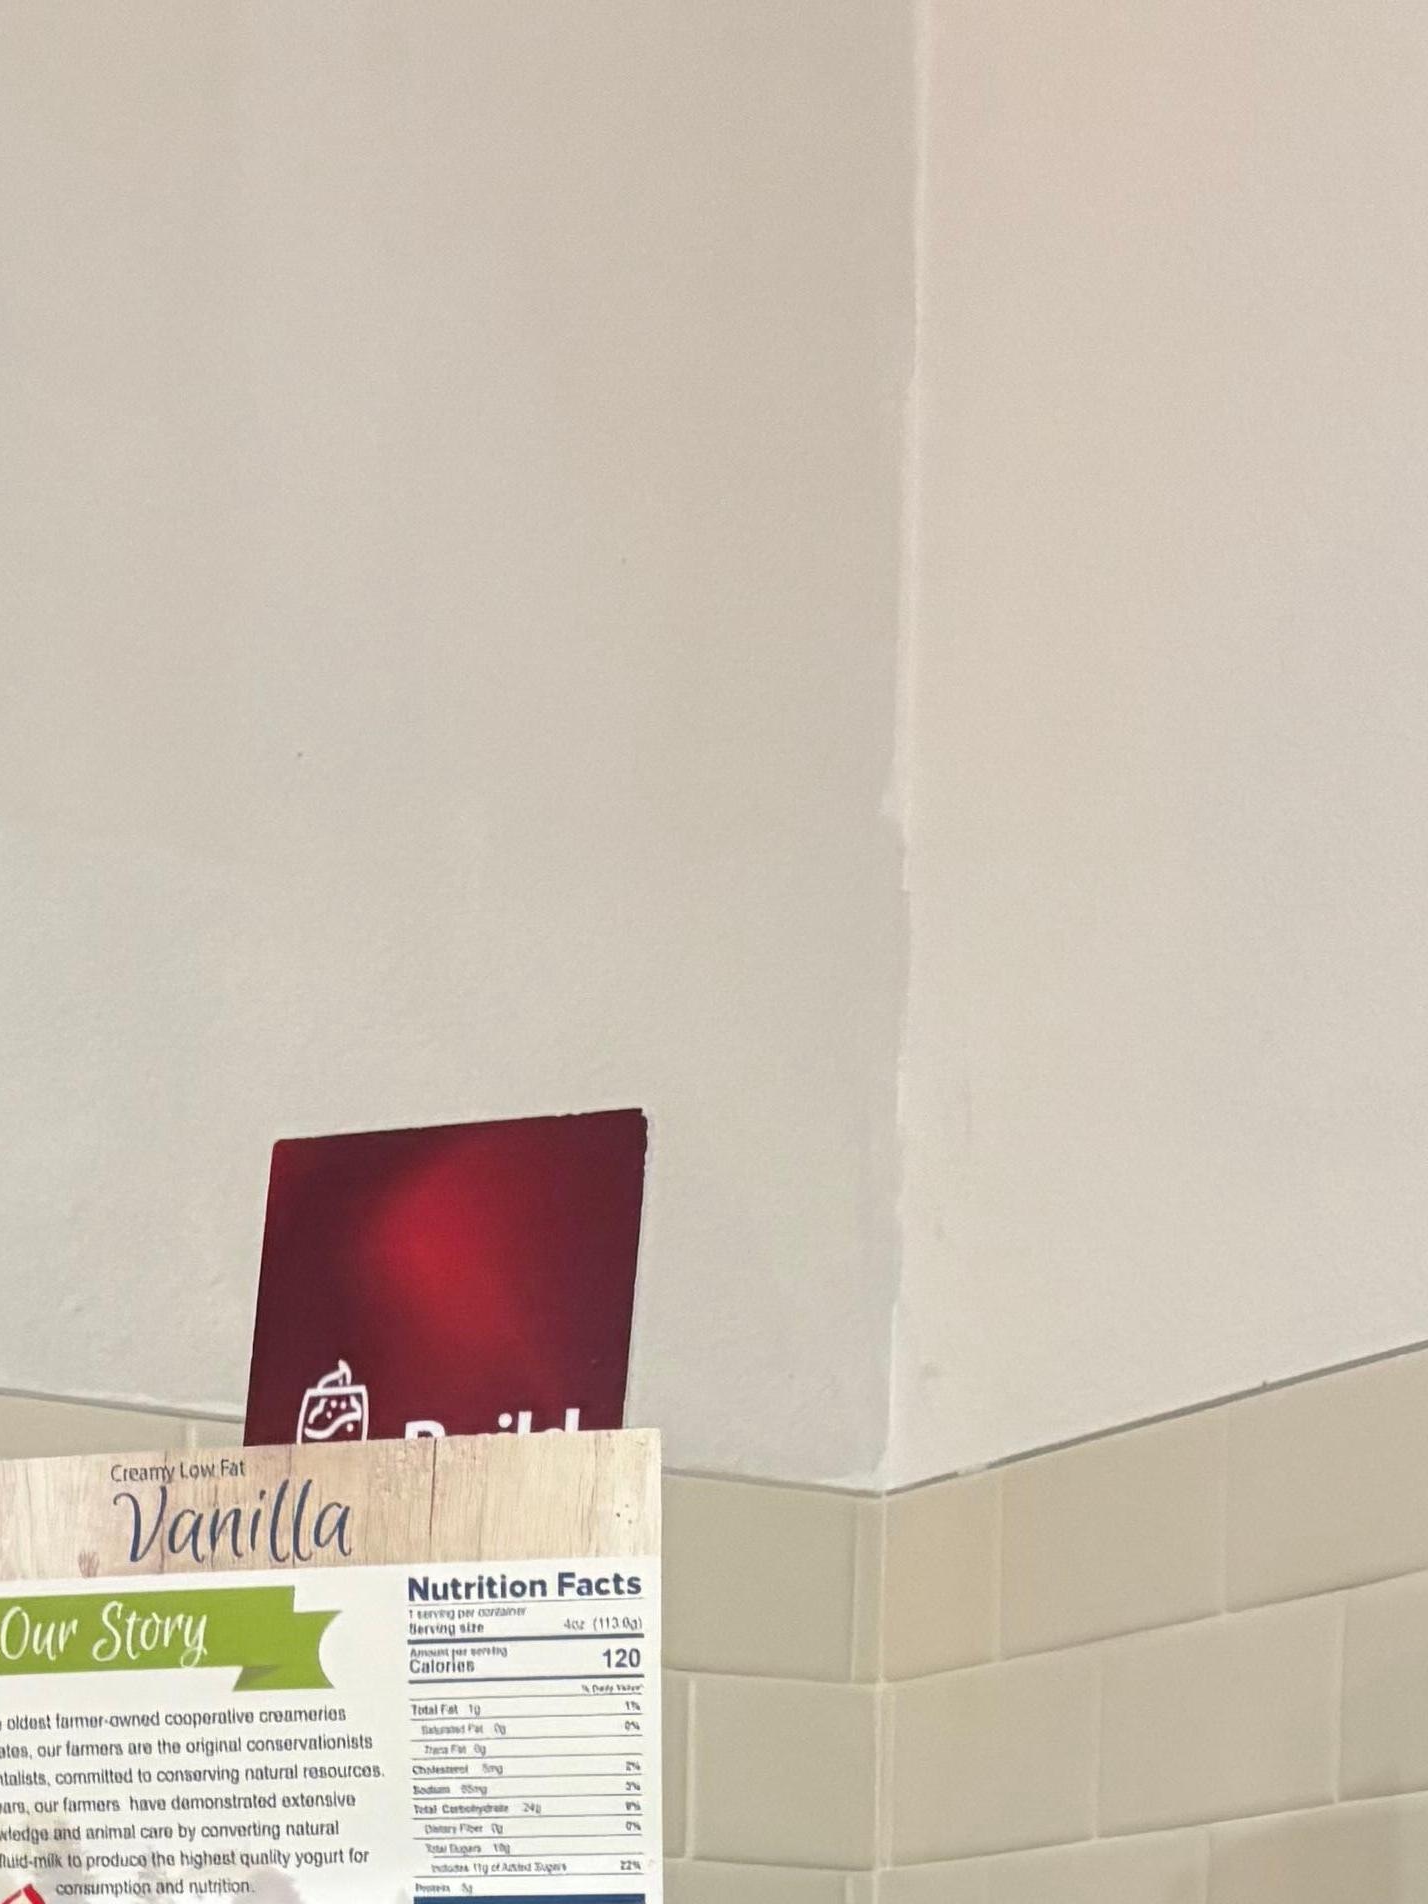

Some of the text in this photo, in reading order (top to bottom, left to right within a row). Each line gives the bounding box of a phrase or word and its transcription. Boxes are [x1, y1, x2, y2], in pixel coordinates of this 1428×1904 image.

[110, 1458, 247, 1484] Creamy Low Fat
[113, 1478, 353, 1563] Vanilla
[408, 1572, 642, 1602] Nutrition Facts
[417, 1607, 455, 1620] serving
[458, 1608, 474, 1619] per
[478, 1606, 526, 1617] container
[0, 1600, 208, 1669] Our Story
[409, 1624, 456, 1636] Serving
[459, 1623, 484, 1633] size
[409, 1648, 641, 1674] Calories 120
[410, 1648, 449, 1658] Amount
[471, 1646, 508, 1658] serving
[7, 1714, 51, 1730] oldest
[56, 1711, 160, 1729] farmer-owned
[165, 1709, 254, 1729] cooperative
[259, 1705, 346, 1724] creameries
[412, 1704, 438, 1716] Total
[441, 1703, 458, 1715] Fat
[37, 1744, 61, 1758] our
[66, 1741, 122, 1757] farmers
[128, 1742, 152, 1755] are
[158, 1739, 181, 1754] the
[186, 1736, 241, 1756] original
[246, 1734, 373, 1752] conservationists
[55, 1768, 133, 1786] committed
[138, 1768, 152, 1782] to
[157, 1766, 240, 1784] conserving
[245, 1764, 298, 1781] natural
[303, 1764, 385, 1779] resources.
[35, 1800, 59, 1813] our
[63, 1797, 120, 1812] farmers
[130, 1796, 166, 1811] have
[171, 1793, 277, 1810] demonstrated
[282, 1791, 356, 1807] extensive
[414, 1804, 437, 1814] Total
[54, 1826, 80, 1840] and
[86, 1824, 135, 1840] animal
[140, 1826, 172, 1839] care
[178, 1823, 196, 1842] by
[201, 1821, 281, 1840] converting
[286, 1820, 339, 1836] natural
[67, 1854, 82, 1868] to
[86, 1852, 147, 1870] produce
[152, 1851, 175, 1866] the
[180, 1850, 236, 1868] highest
[240, 1849, 291, 1868] quality
[295, 1848, 344, 1868] yogurt
[349, 1847, 370, 1863] for
[55, 1879, 255, 1897] consumption and nutrition.
